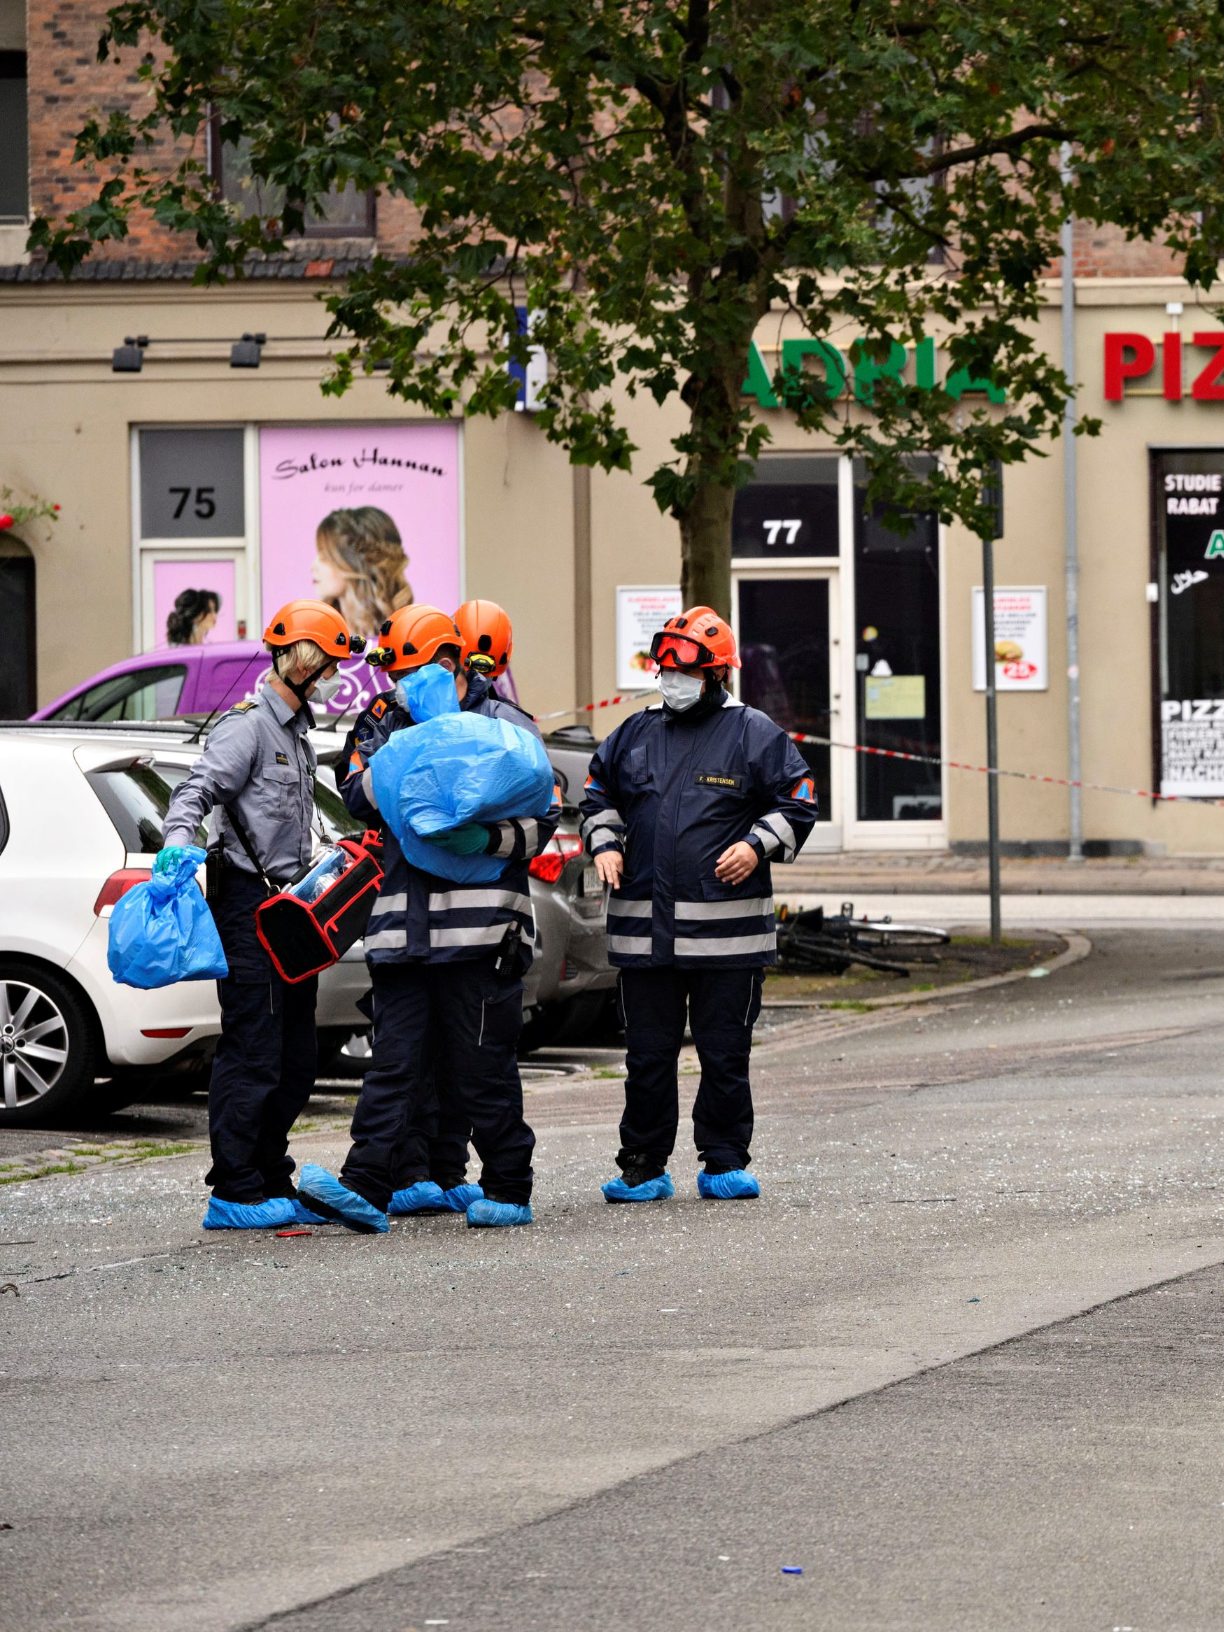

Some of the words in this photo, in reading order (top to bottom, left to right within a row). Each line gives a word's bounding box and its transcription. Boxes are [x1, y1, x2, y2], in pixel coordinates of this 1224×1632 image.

[272, 452, 345, 480] Salon
[353, 447, 446, 477] Hannan
[324, 482, 346, 493] kun
[347, 482, 365, 496] for
[367, 481, 404, 493] damer
[1164, 473, 1222, 492] STUDIE
[169, 486, 216, 520] 75
[1166, 497, 1220, 515] RABAT
[763, 519, 802, 545] 77
